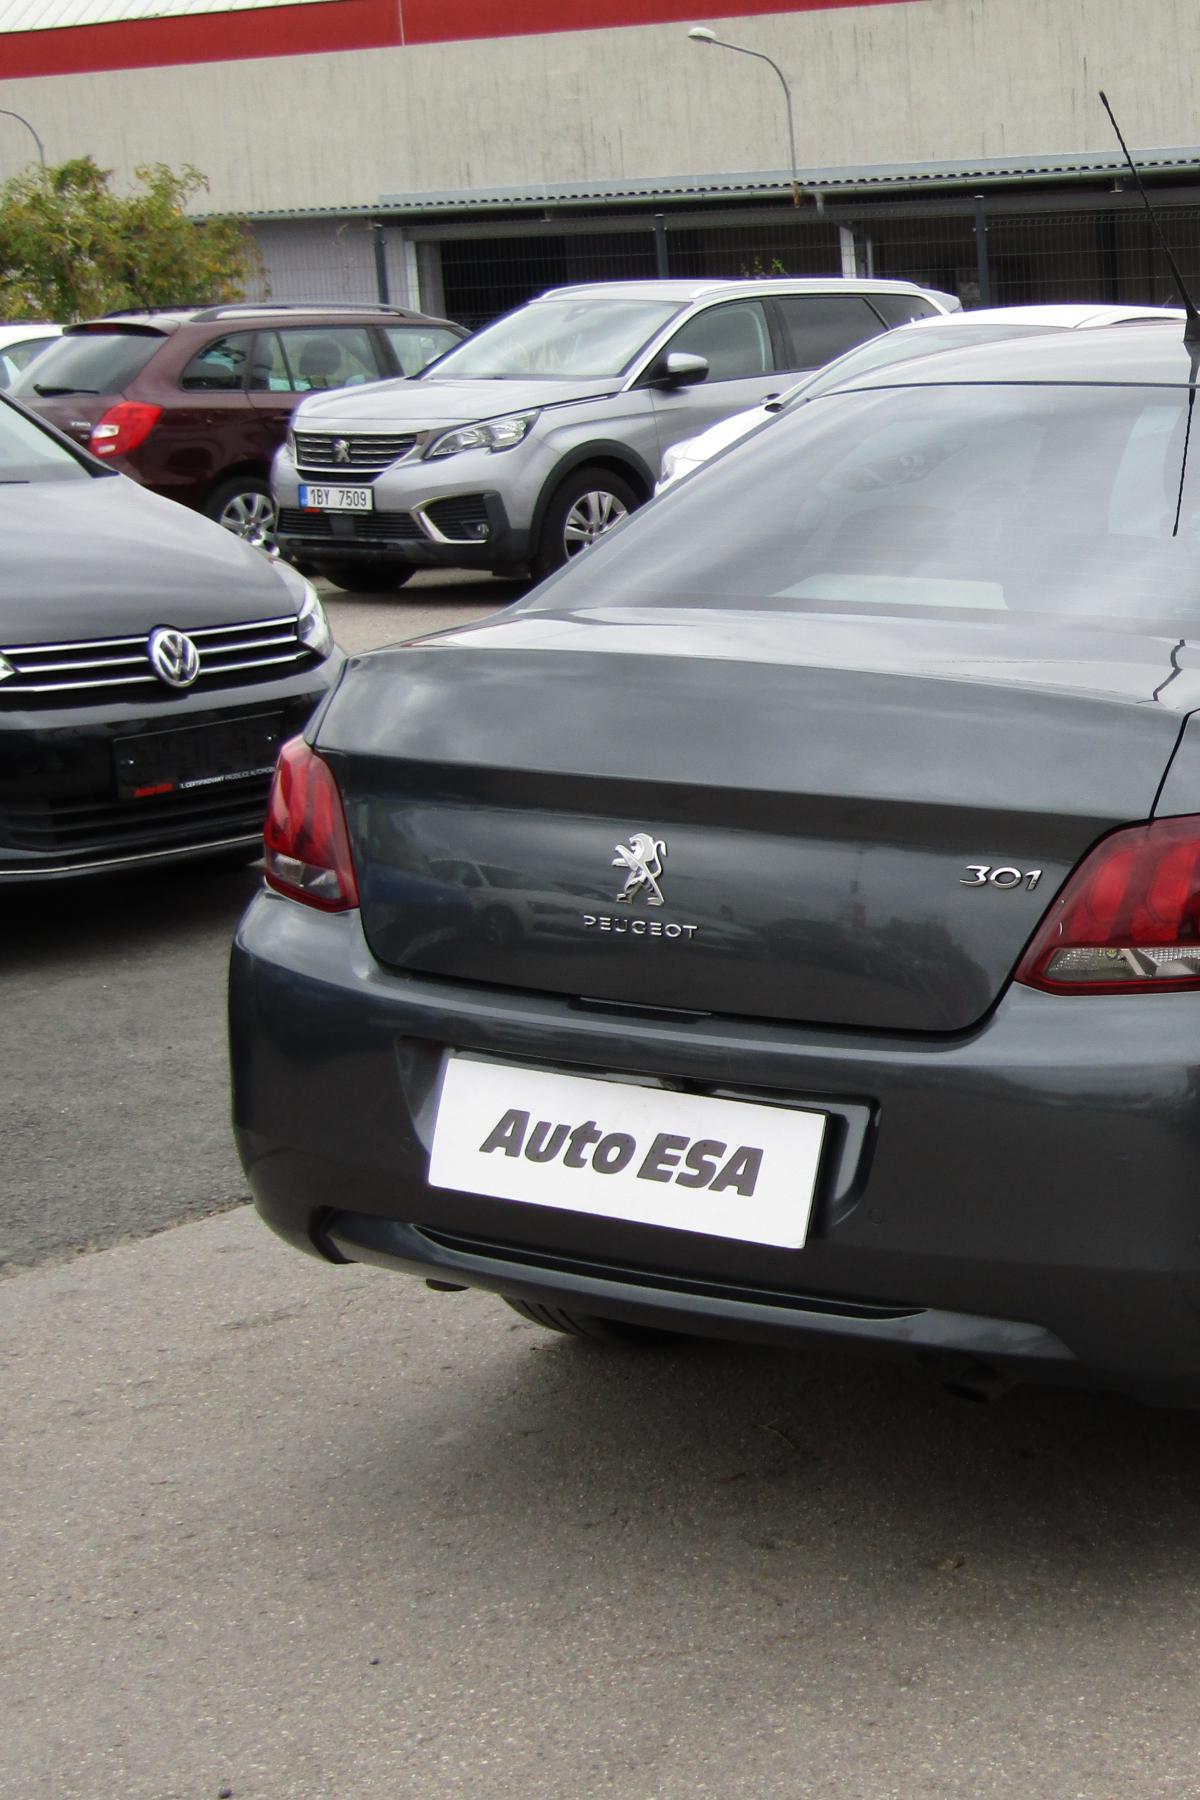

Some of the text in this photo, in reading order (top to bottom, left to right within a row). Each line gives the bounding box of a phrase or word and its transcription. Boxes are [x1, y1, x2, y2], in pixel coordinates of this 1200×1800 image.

[310, 489, 330, 505] 1BY
[338, 490, 367, 507] 7509
[959, 865, 1042, 890] 301
[583, 914, 698, 938] PEUGEOT
[479, 1108, 764, 1197] Auto ESA
